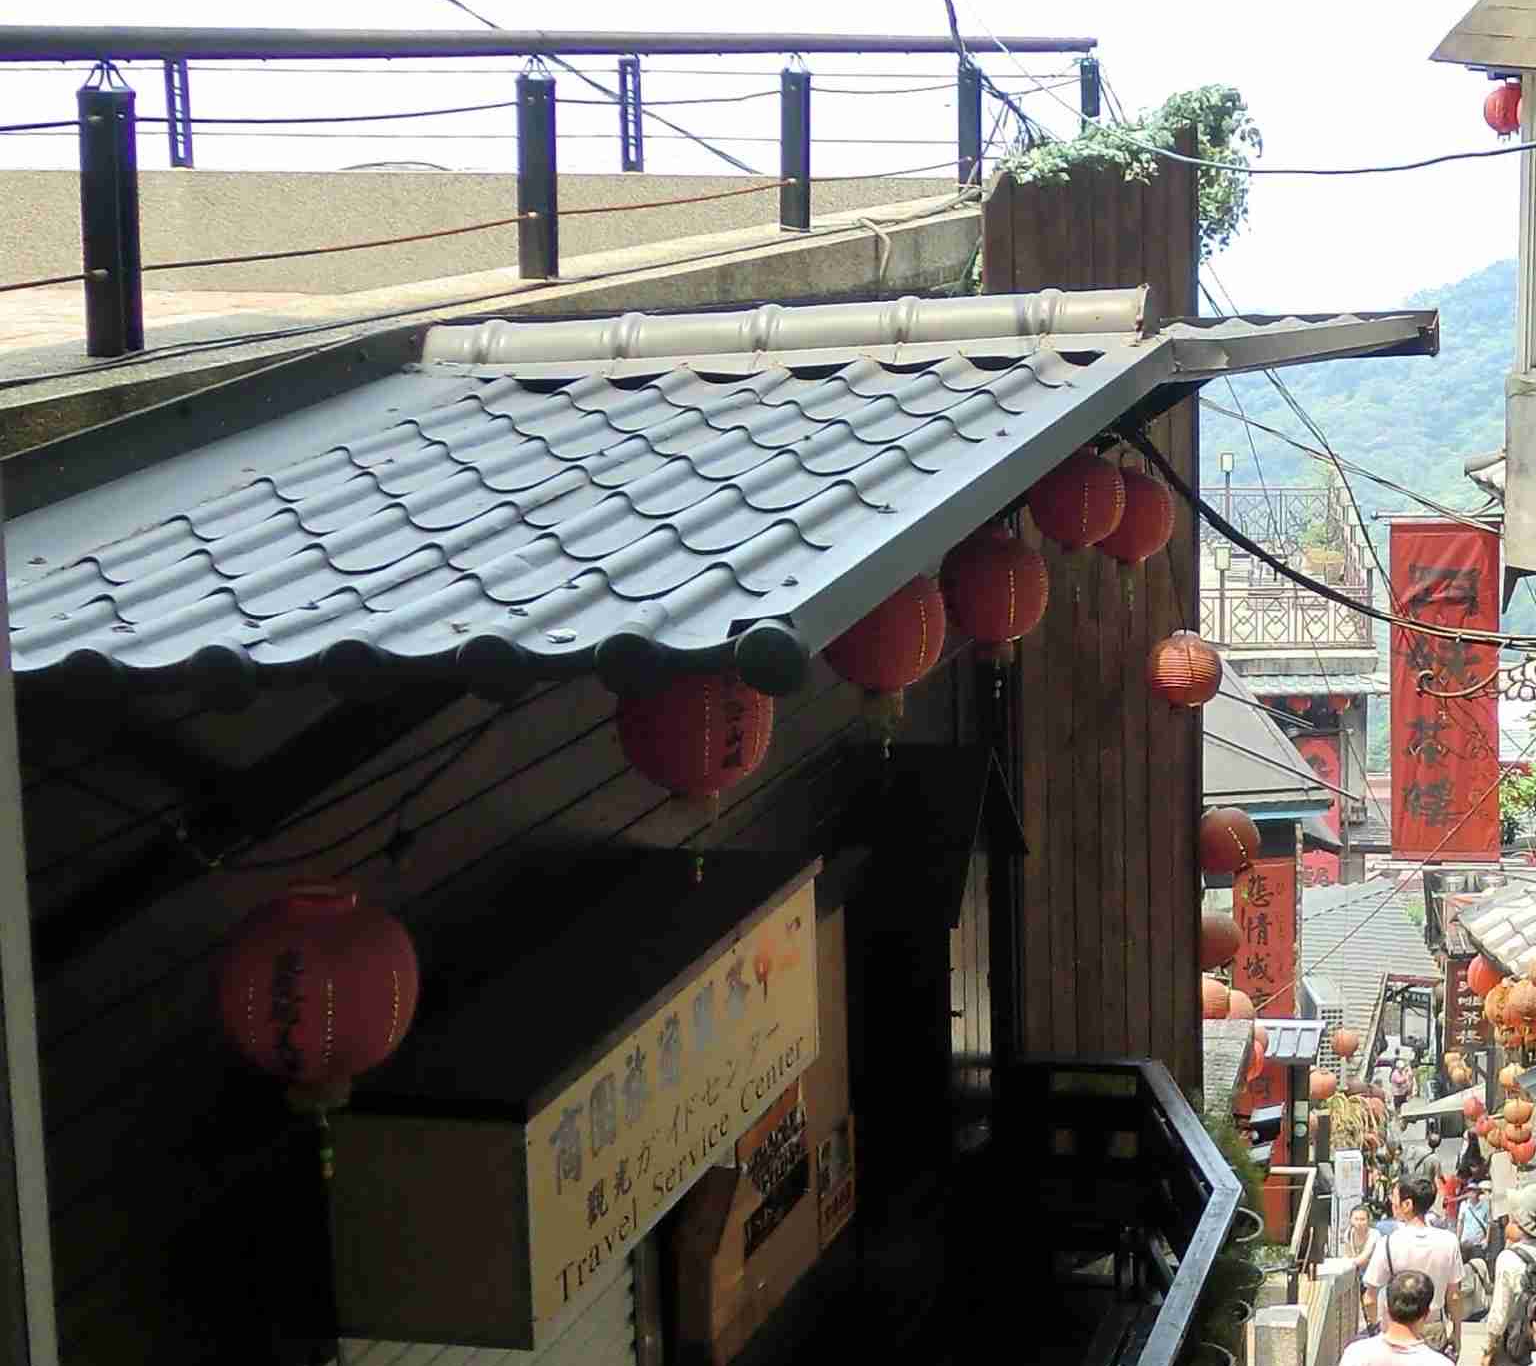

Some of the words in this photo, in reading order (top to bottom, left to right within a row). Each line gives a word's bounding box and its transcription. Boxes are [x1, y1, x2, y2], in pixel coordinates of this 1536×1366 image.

[555, 1197, 638, 1302] Travel
[653, 1113, 730, 1197] Service
[739, 1036, 804, 1114] Center
